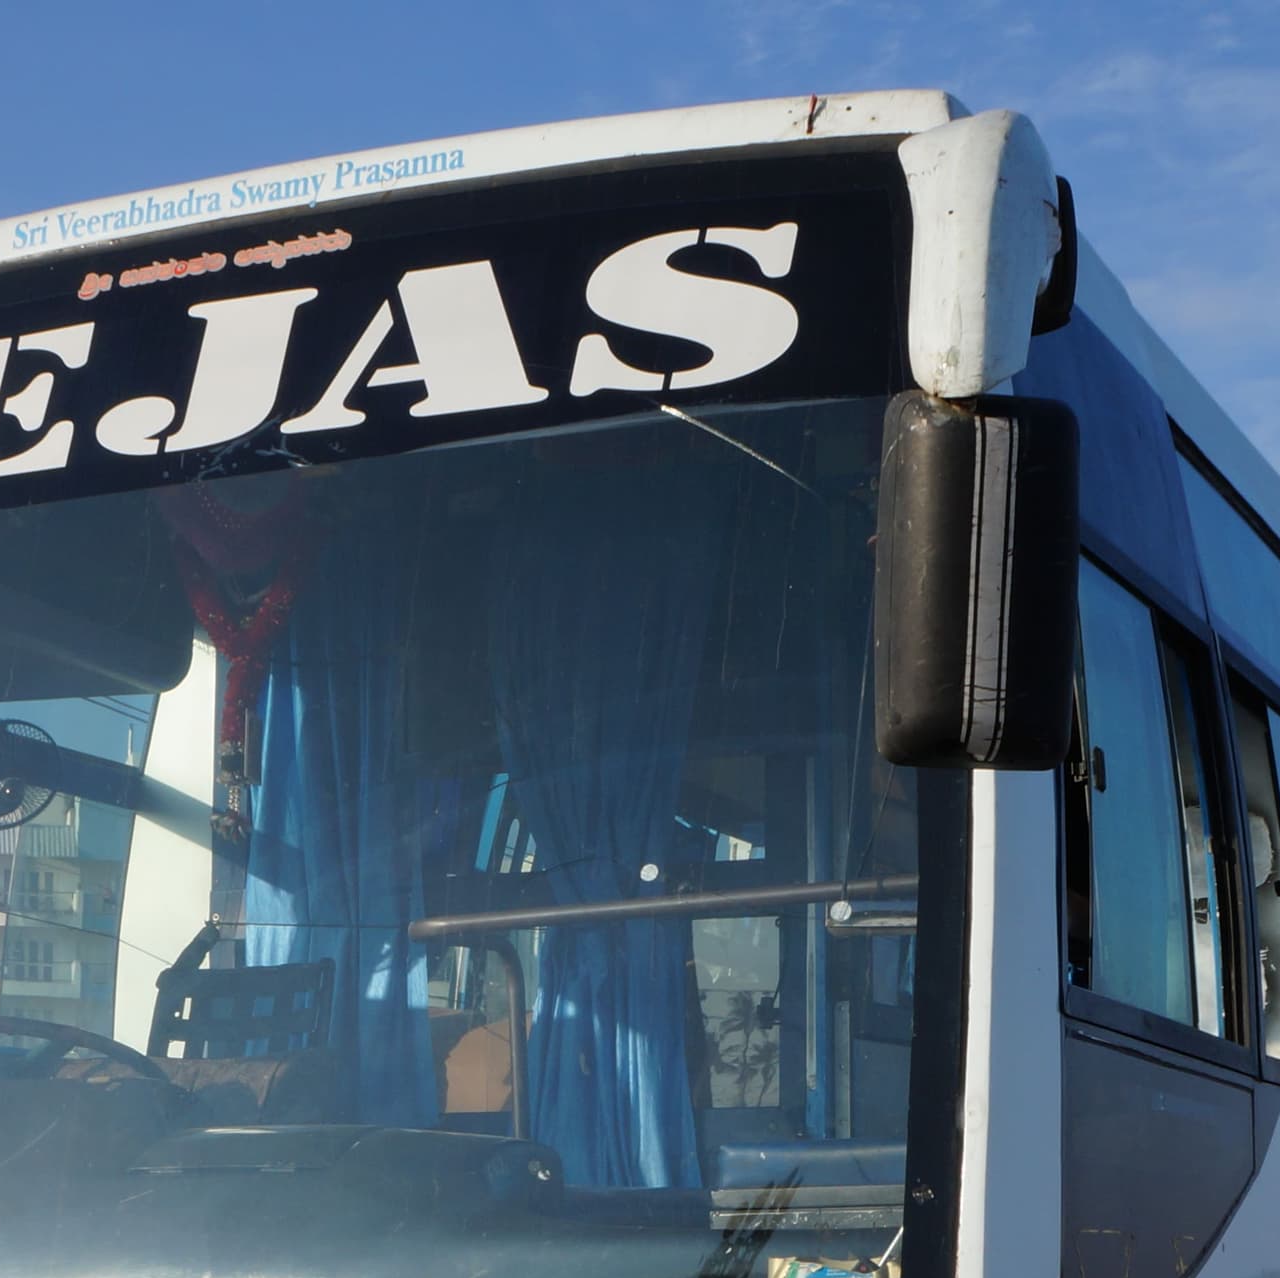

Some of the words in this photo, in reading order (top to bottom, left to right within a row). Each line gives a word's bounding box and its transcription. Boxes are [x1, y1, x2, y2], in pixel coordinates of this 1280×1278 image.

[11, 214, 49, 250] Sri
[57, 187, 221, 241] Veerabhadra
[230, 172, 327, 208] Swamy
[334, 148, 465, 190] Prasanna
